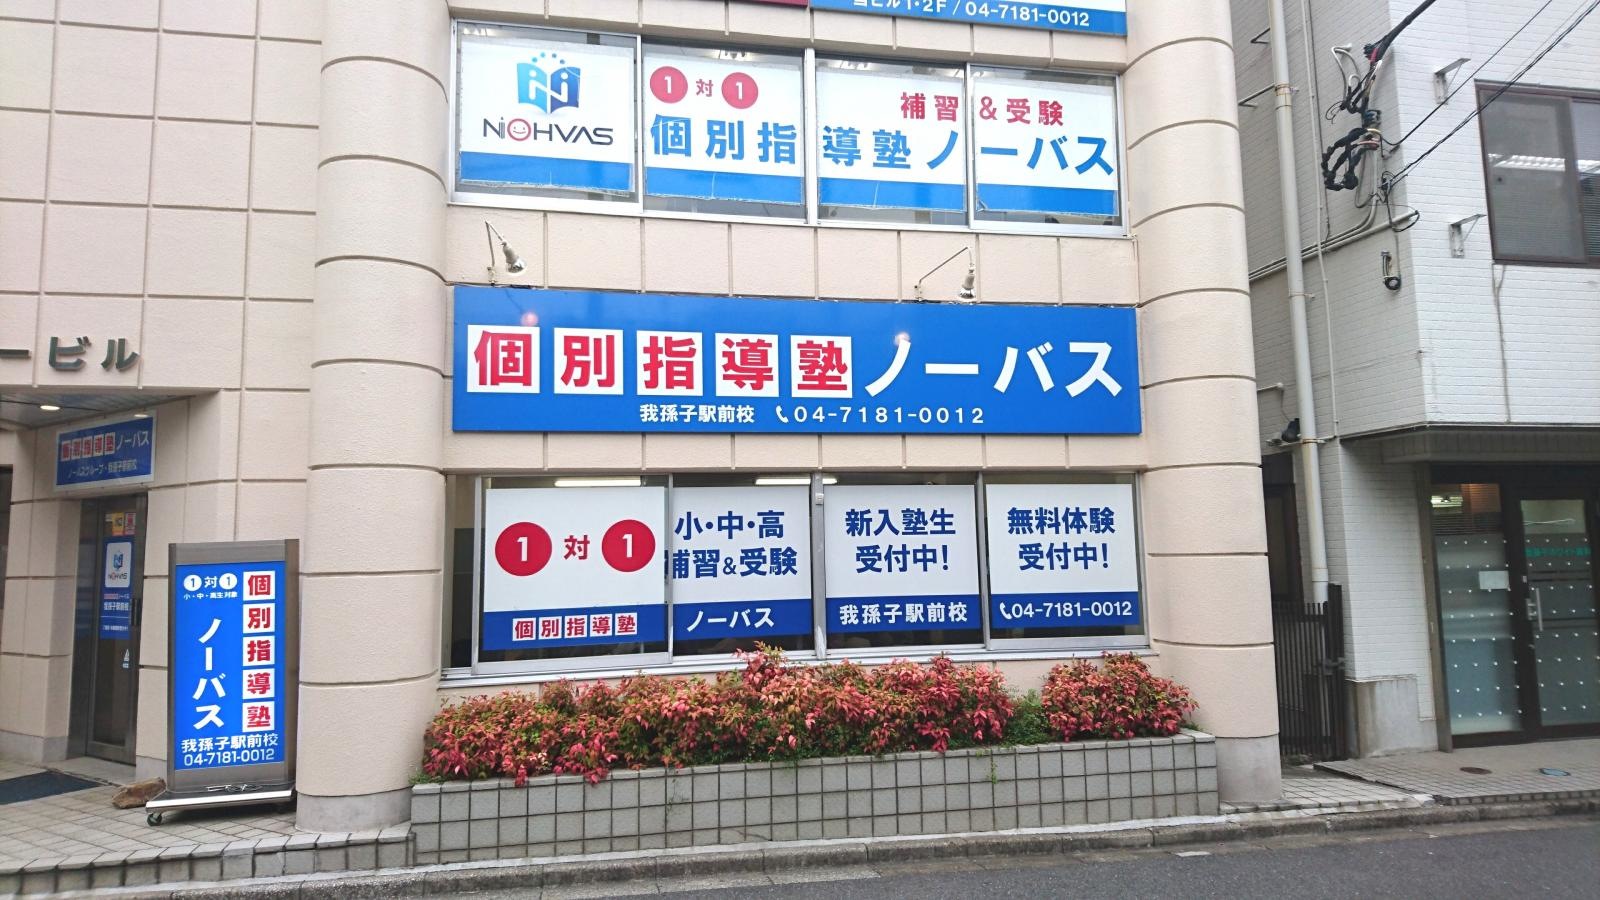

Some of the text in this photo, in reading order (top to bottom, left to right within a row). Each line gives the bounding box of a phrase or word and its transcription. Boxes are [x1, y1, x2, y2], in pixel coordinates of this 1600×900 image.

[639, 403, 985, 424] 我孫子駅前校 04-7181-0012
[845, 508, 956, 537] 新入塾生
[1007, 507, 1116, 535] 無料体験
[855, 544, 950, 574] 受付中!
[1018, 543, 1110, 571] 受付中!
[686, 607, 775, 632] ノーバス
[839, 602, 968, 625] 我孫子駅前校
[1011, 601, 1133, 619] 04-7181-0012
[513, 614, 637, 640] 個別指導塾
[245, 573, 274, 730] 個別指導塾
[192, 618, 226, 730] ノーバス
[181, 733, 279, 753] 我孫子駅前校
[183, 748, 275, 767] 04-7181-0012
